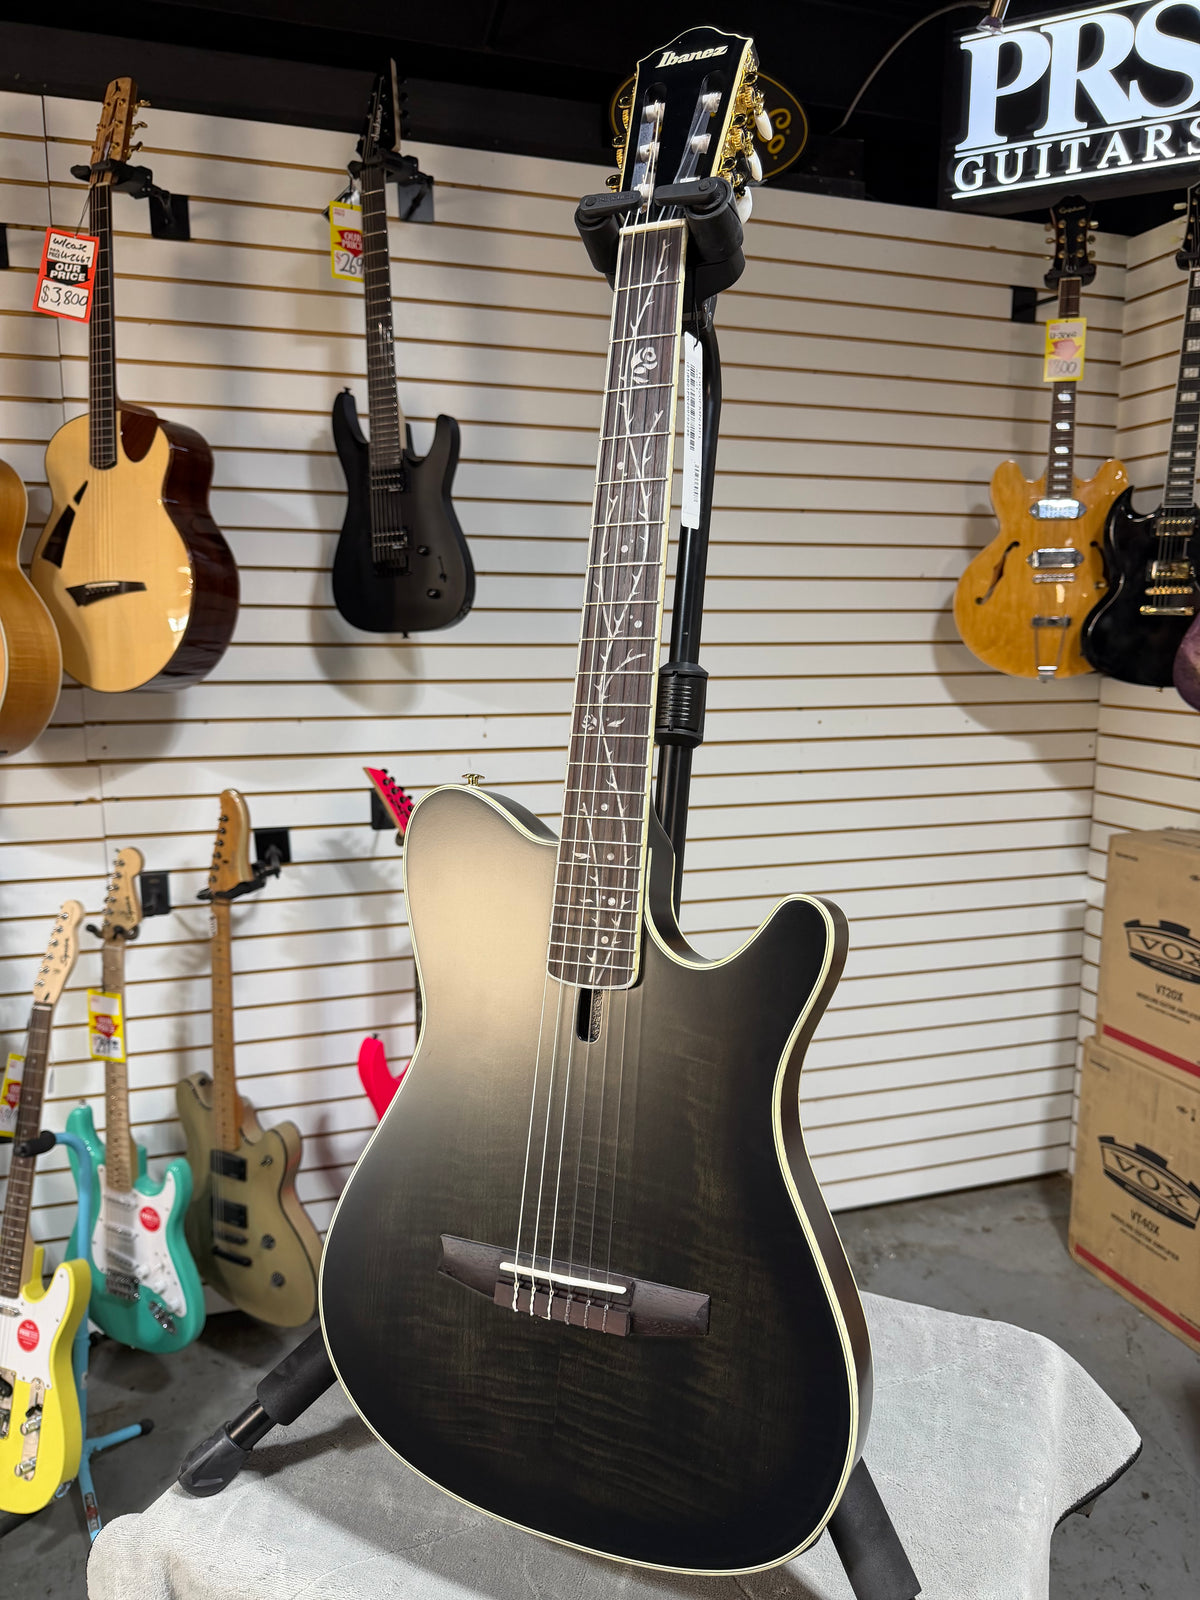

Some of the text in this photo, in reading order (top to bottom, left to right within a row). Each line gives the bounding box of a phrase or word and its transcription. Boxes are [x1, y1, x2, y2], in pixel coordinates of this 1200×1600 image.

[655, 45, 728, 69] Ibanez
[955, 0, 1200, 151] PRS
[954, 118, 1200, 192] GUITARS
[50, 271, 86, 281] PRICE
[55, 262, 81, 273] OUR
[41, 285, 88, 306] $3,800
[1110, 1150, 1190, 1212] VOX
